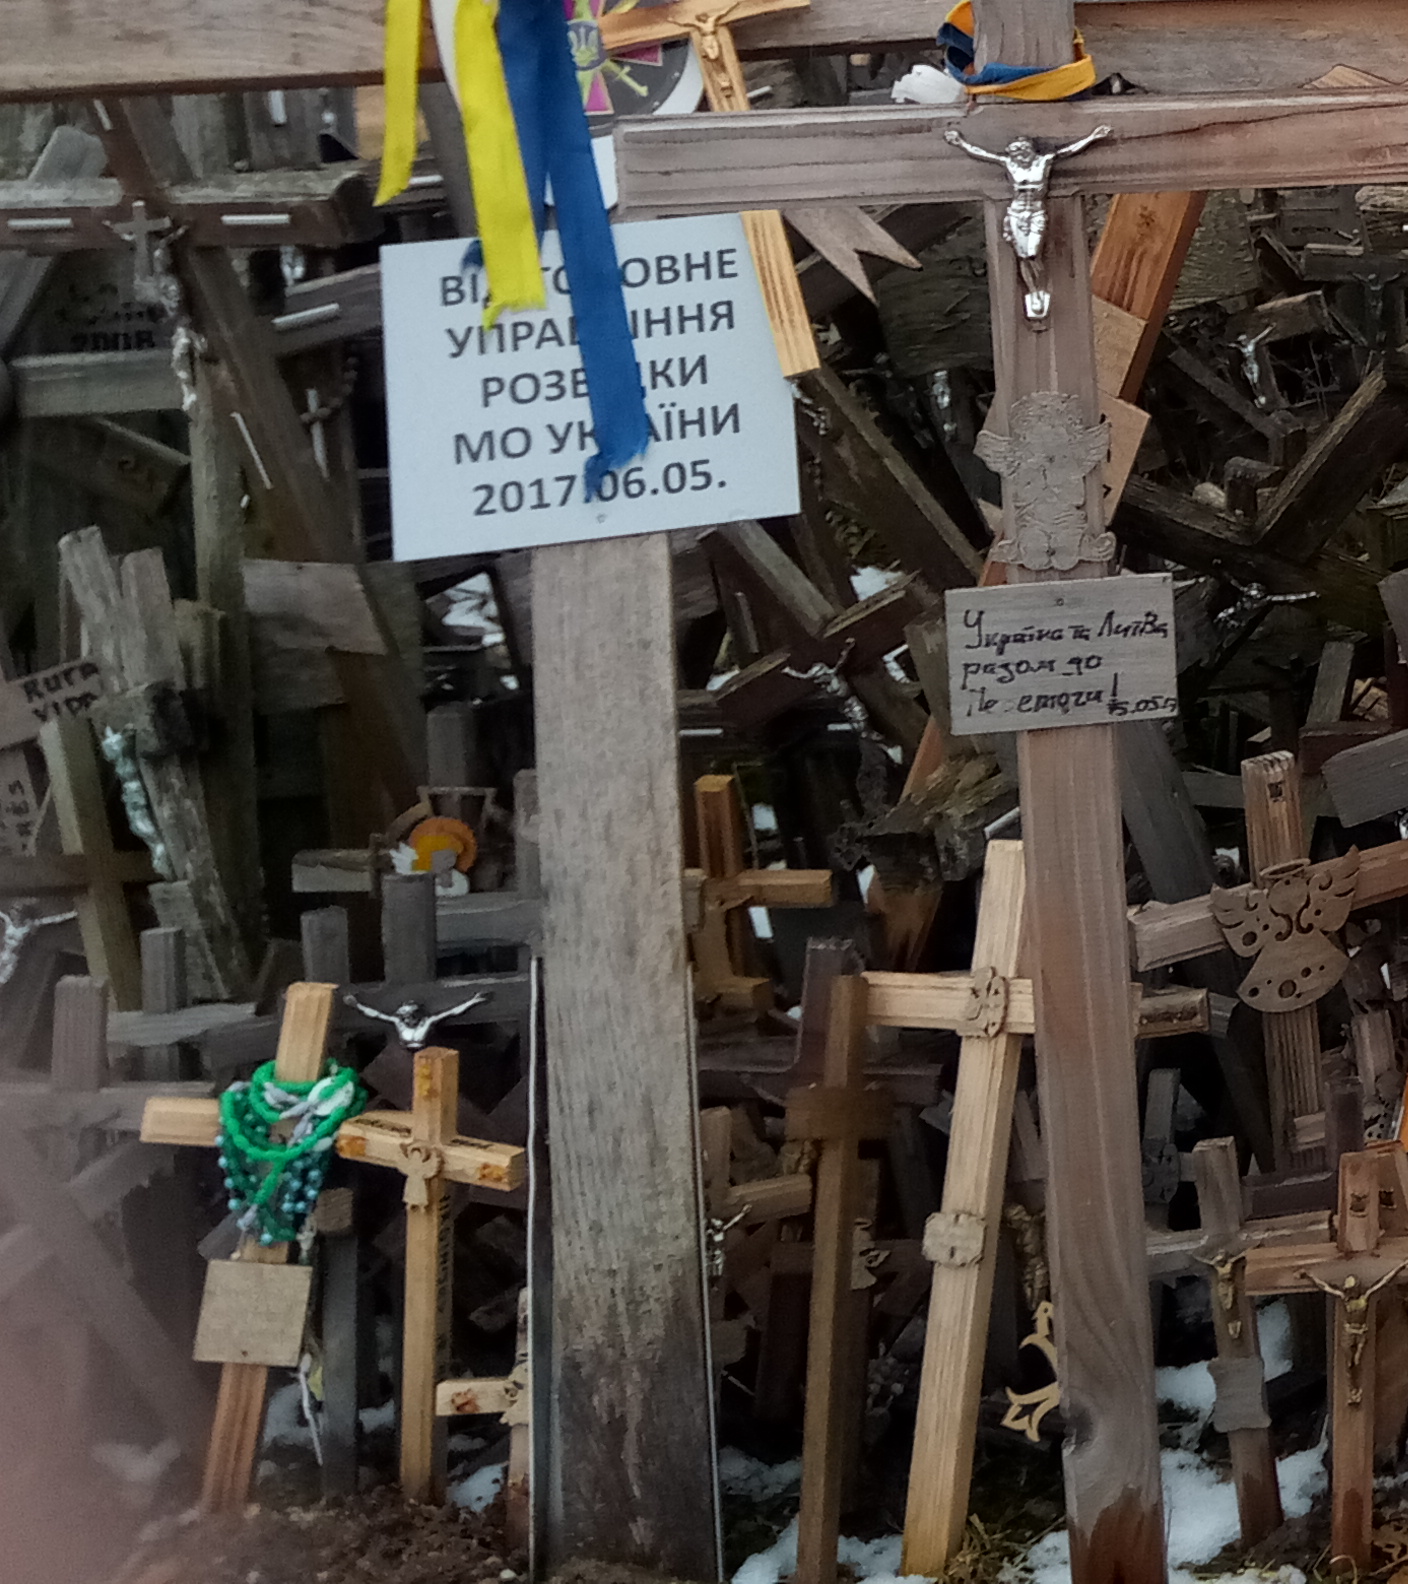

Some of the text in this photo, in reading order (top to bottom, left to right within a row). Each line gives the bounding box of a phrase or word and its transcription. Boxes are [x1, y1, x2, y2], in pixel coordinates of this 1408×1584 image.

[439, 273, 493, 307] ВІ
[446, 299, 735, 358] УПРАІННЯ
[481, 354, 708, 408] РОЗВКИ
[454, 402, 741, 464] МО УКЇНИ
[473, 459, 727, 516] 201706.05.
[961, 657, 1057, 690] разом
[967, 673, 1119, 717] Пеемоги!
